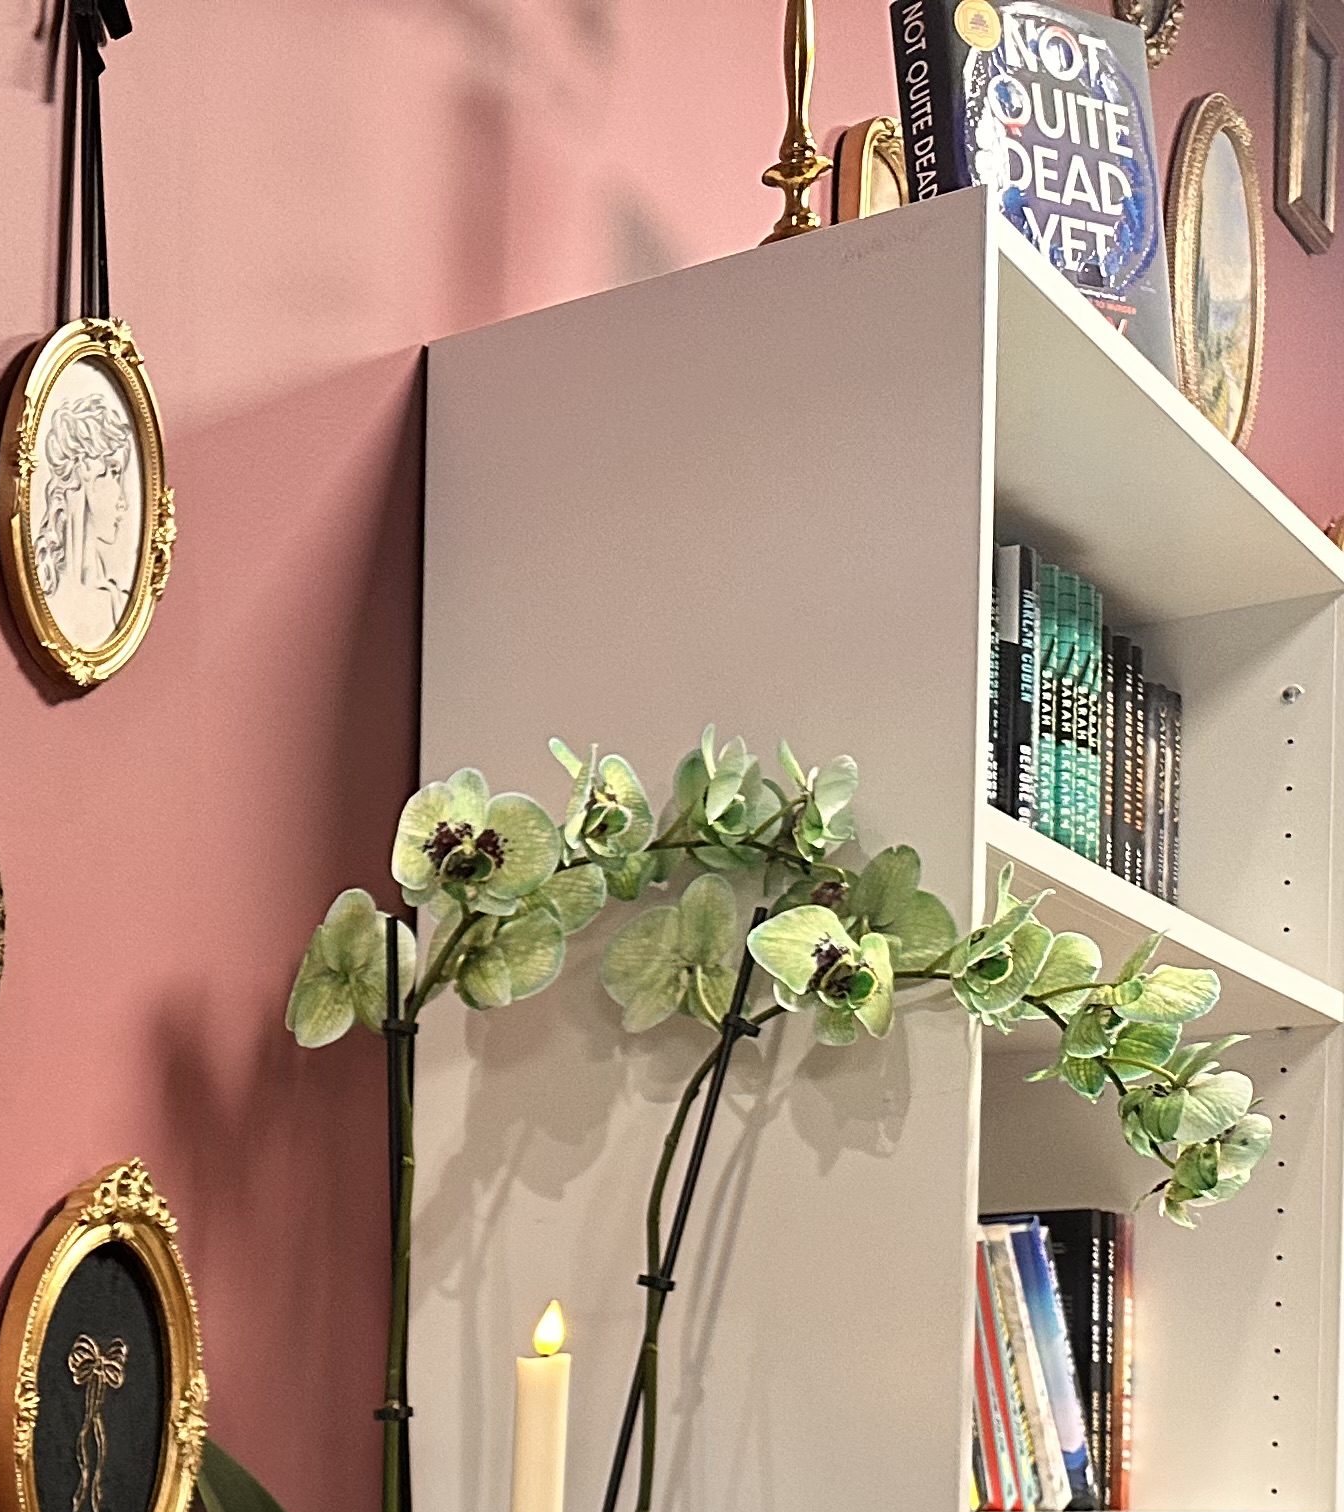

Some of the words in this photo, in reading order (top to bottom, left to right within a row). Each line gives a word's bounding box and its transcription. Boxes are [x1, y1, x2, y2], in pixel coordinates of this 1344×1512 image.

[902, 0, 924, 55] NOT
[1003, 14, 1107, 90] NOT
[905, 60, 932, 136] QUITE
[987, 74, 1133, 159] QUITE
[913, 141, 938, 201] DEAD
[1003, 138, 1132, 216] DEAD
[1022, 206, 1115, 277] YET
